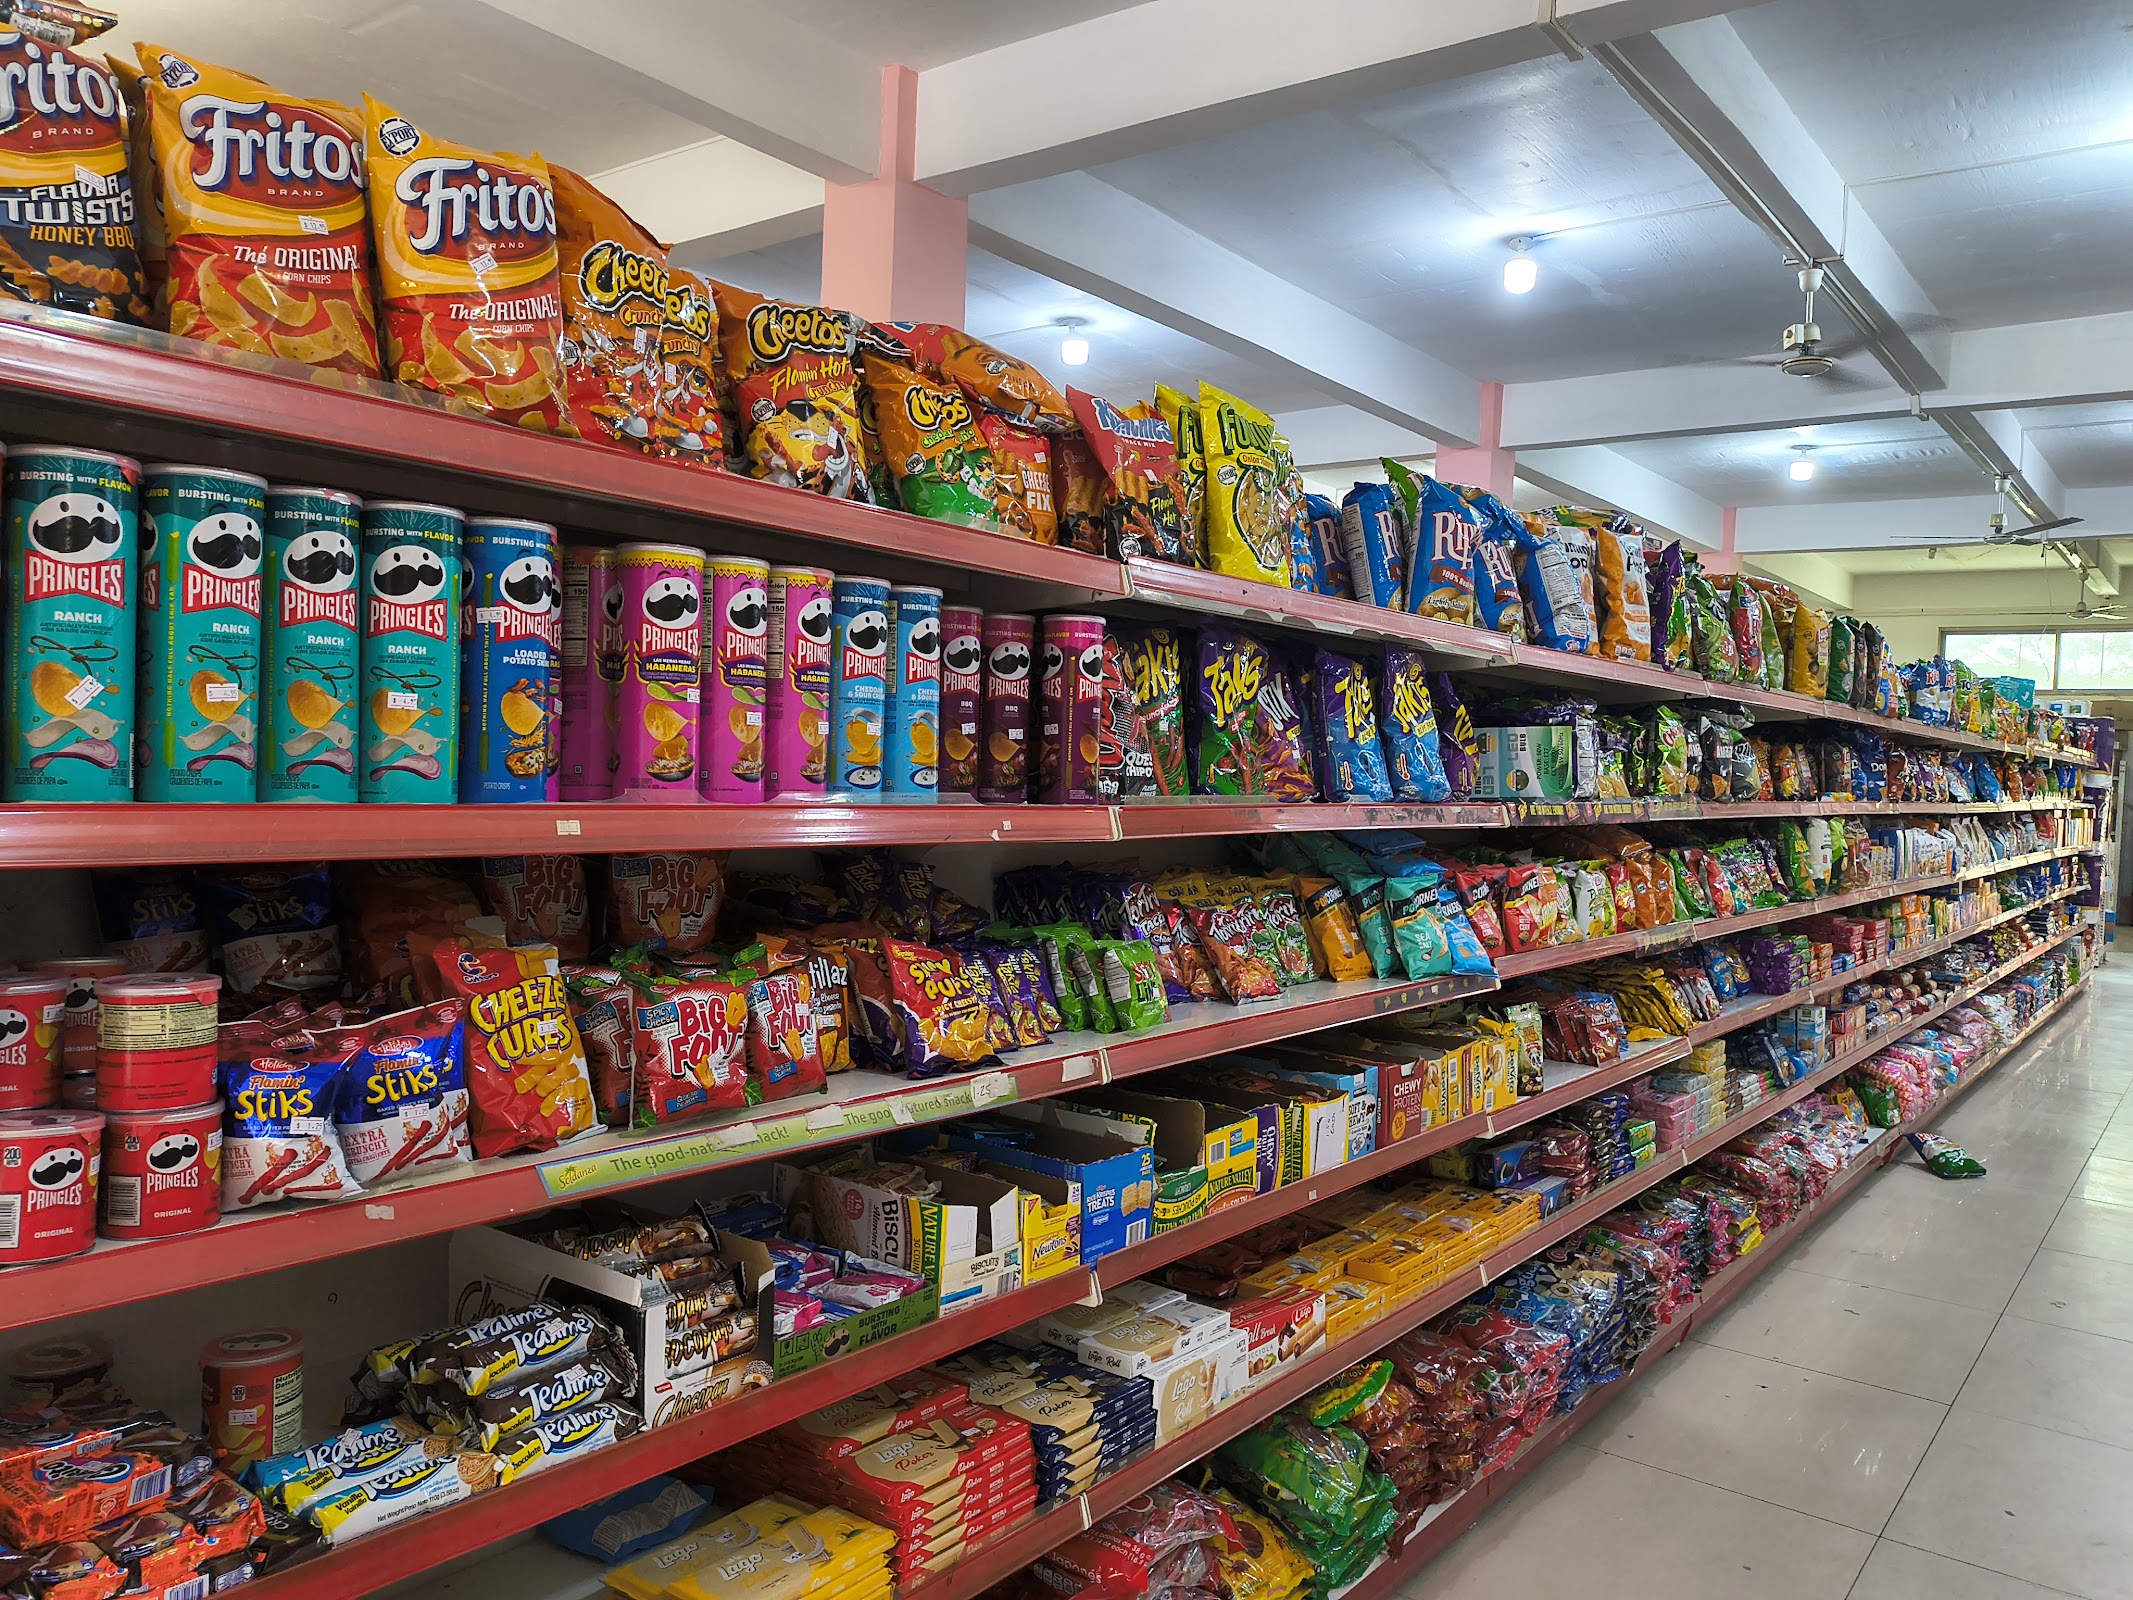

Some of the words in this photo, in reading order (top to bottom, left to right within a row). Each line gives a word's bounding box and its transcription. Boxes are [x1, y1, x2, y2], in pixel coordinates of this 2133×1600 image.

[33, 128, 94, 139] BRAND
[267, 188, 324, 197] BRAND
[30, 225, 97, 248] HONEY
[234, 245, 266, 264] The
[478, 242, 525, 250] BRAND
[307, 273, 332, 285] CHIPS
[449, 304, 479, 320] The
[516, 323, 535, 333] CHIPS
[747, 303, 848, 362] Cheetos
[769, 365, 820, 399] Flamin'
[820, 355, 850, 378] Hot
[1143, 440, 1157, 448] MIX
[20, 471, 74, 483] BURSTING
[178, 488, 231, 502] BURSTING
[1027, 492, 1052, 513] FIX
[274, 511, 323, 522] BURSTING
[406, 530, 424, 538] WITH
[424, 531, 455, 543] FLAVOR
[492, 536, 535, 549] BURSTING
[28, 554, 122, 604] PRINGLES
[187, 569, 261, 614] PRINGLES
[841, 595, 873, 605] BURSTING
[283, 586, 357, 628] PRINGLES
[902, 603, 932, 611] BURSTING
[54, 610, 103, 624] RANCH
[370, 602, 445, 642] PRINGLES
[212, 622, 250, 634] RANCH
[307, 635, 345, 647] RANCH
[642, 624, 699, 655] PRINGLES
[388, 645, 427, 656] RANCH
[514, 648, 547, 660] LOADED
[503, 656, 536, 666] POTATO
[645, 662, 696, 674] HABANERAS
[988, 677, 1029, 699] PRINGLES
[960, 700, 974, 708] BBQ
[1005, 705, 1019, 713] BBQ
[1507, 732, 1518, 761] LED
[1519, 733, 1527, 752] BULB
[132, 892, 197, 926] Stiks
[245, 896, 304, 927] Stiks
[1415, 933, 1430, 942] SEA
[470, 977, 566, 1033] CHEEZE
[646, 1005, 672, 1019] SPICY
[932, 1003, 954, 1015] SPICY
[645, 1014, 677, 1029] cheese
[676, 997, 729, 1038] BiG
[486, 1011, 572, 1072] CURLS
[669, 1022, 745, 1077] FOOT
[249, 1075, 305, 1091] Flamin'
[366, 1064, 438, 1104] Stiks
[1393, 1078, 1422, 1097] CHEWY
[234, 1088, 314, 1122] Stiks
[1393, 1092, 1421, 1110] PROTEIN
[1406, 1104, 1421, 1116] BARS
[414, 1108, 429, 1117] 1.25
[844, 1112, 867, 1127] The
[307, 1121, 323, 1130] 1.25
[344, 1127, 385, 1147] EXTRA
[345, 1139, 388, 1158] CRUNCHY
[1266, 1126, 1276, 1171] CHEWY
[1141, 1153, 1151, 1165] 25
[147, 1166, 199, 1194] PRINGLES
[559, 1163, 598, 1189] Soldanza
[610, 1156, 642, 1172] The
[1208, 1176, 1231, 1198] NATURE
[1231, 1168, 1253, 1186] VALLEY
[27, 1184, 83, 1213] PRINGLES
[1087, 1197, 1115, 1214] TREATS
[154, 1206, 192, 1219] ORIGINAL
[34, 1226, 75, 1239] ORIGINAL
[922, 1202, 941, 1263] NATURE
[911, 1238, 920, 1248] 30
[1033, 1235, 1068, 1263] Newtons
[970, 1257, 1000, 1274] BISCUITS
[858, 1305, 901, 1328] BURSTING
[1292, 1305, 1312, 1322] Lago
[870, 1318, 888, 1330] WITH
[1112, 1322, 1140, 1340] Lago
[859, 1323, 898, 1347] FLAVOR
[1133, 1328, 1156, 1345] Roll
[1105, 1353, 1122, 1368] Roll
[982, 1379, 1015, 1398] Poker
[1171, 1376, 1198, 1402] Lago
[1039, 1397, 1073, 1418] Poker
[1174, 1401, 1193, 1424] Roll
[874, 1441, 914, 1463] Lago
[894, 1450, 935, 1473] Poker
[301, 1469, 330, 1488] Vanilla
[335, 1491, 364, 1511] Vanilla
[345, 1498, 368, 1515] Vainilla
[652, 1541, 700, 1569] Lago
[1131, 1544, 1141, 1554] 38
[716, 1552, 764, 1581] Lago
